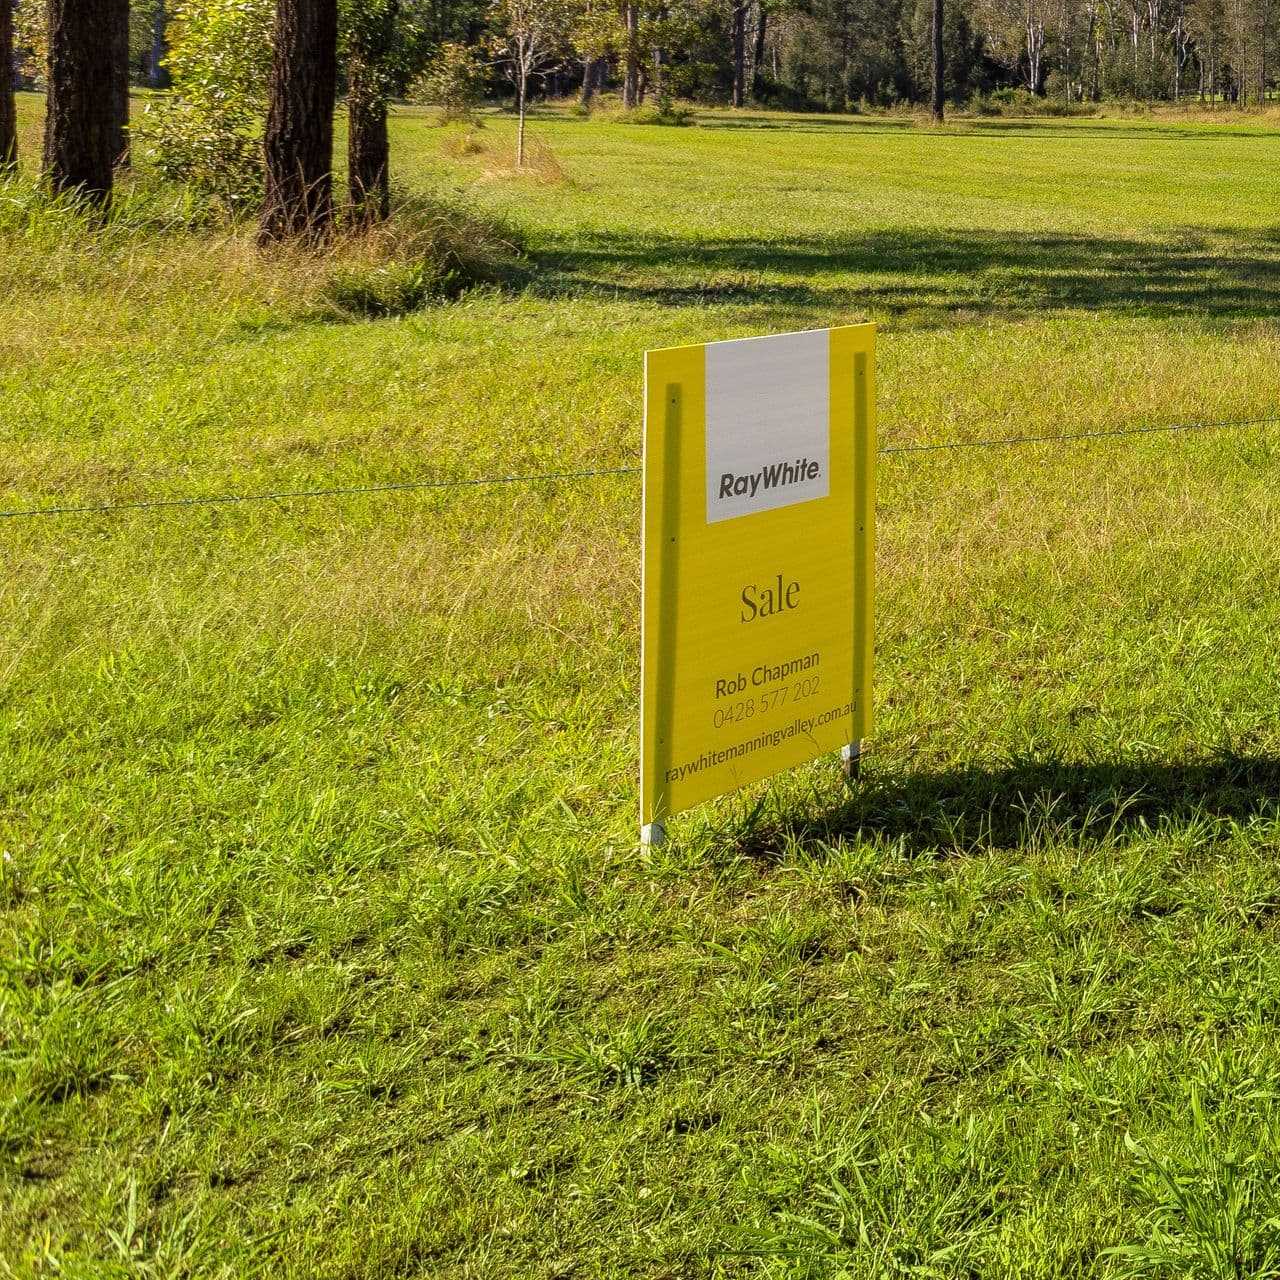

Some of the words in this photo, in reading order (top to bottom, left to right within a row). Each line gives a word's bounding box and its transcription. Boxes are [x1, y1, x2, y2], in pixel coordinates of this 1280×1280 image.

[741, 574, 801, 623] Sale
[715, 673, 747, 699] Rob
[751, 652, 820, 686] Chapman
[713, 698, 755, 729] 0428
[760, 686, 789, 713] 577
[792, 675, 820, 702] 202
[664, 701, 857, 784] raywhitemanningvalley.com.au
